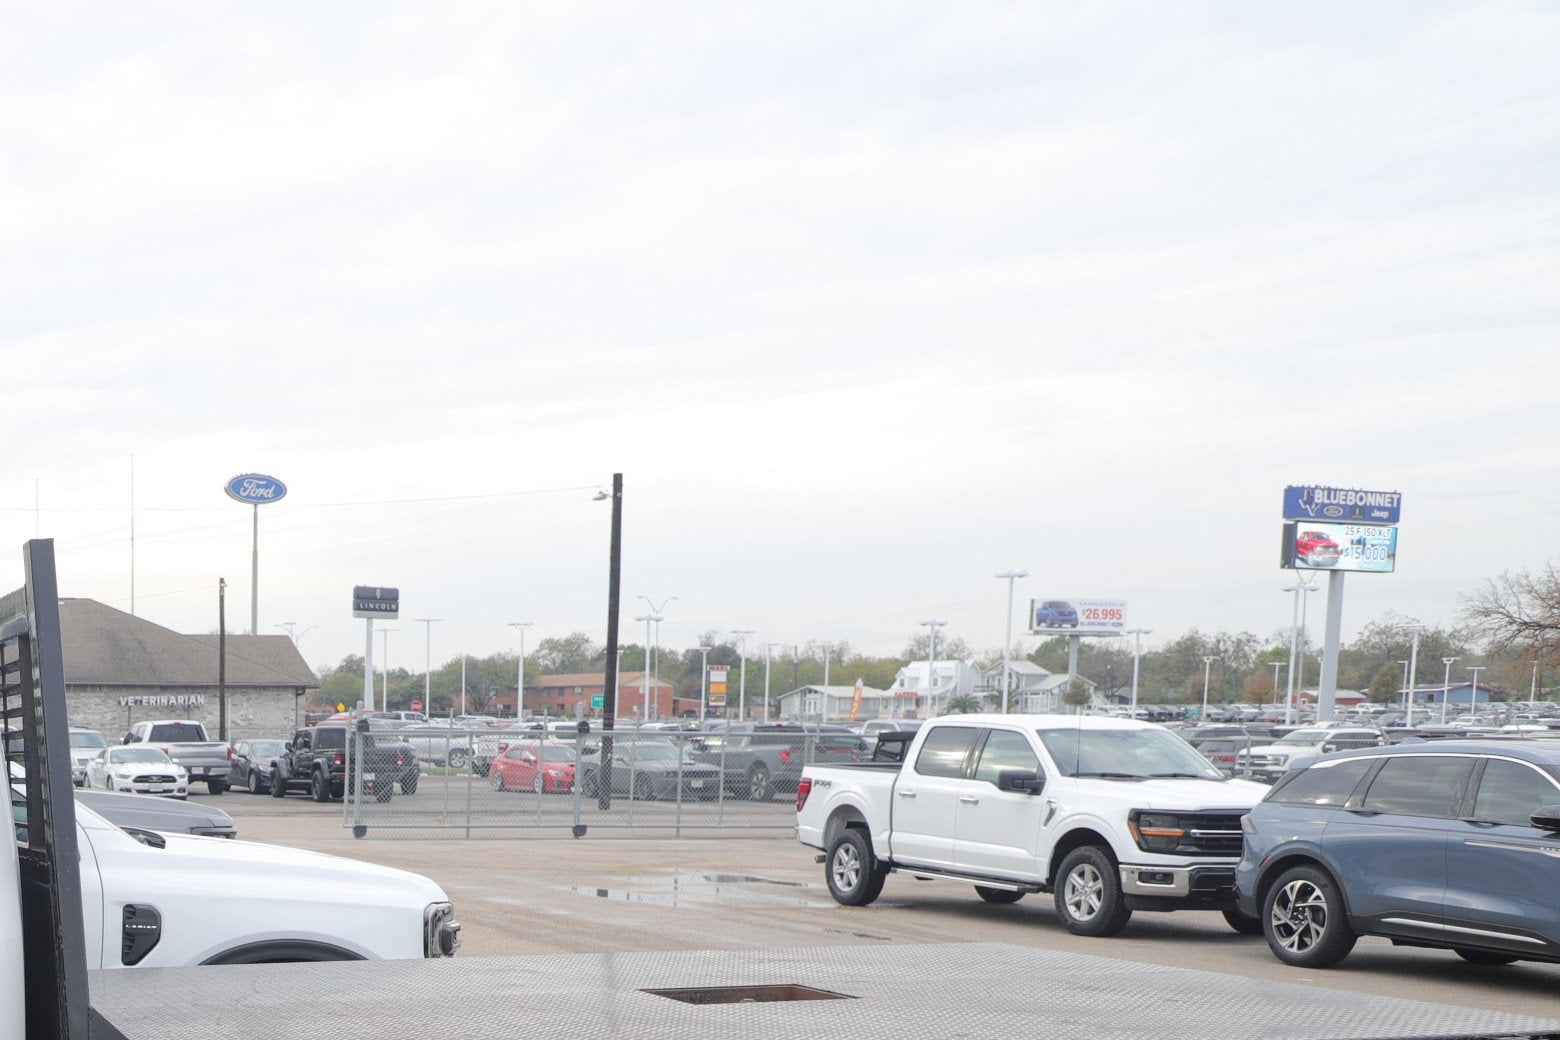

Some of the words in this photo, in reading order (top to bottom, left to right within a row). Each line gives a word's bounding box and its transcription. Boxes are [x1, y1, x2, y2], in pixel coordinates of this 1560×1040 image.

[240, 479, 275, 497] Ford
[1314, 489, 1400, 507] BLUEBONNET
[1371, 509, 1389, 518] Jeep
[1378, 529, 1391, 538] XLT
[1343, 546, 1387, 560] $15,000
[360, 602, 397, 610] LINCOLN
[120, 695, 205, 706] VETERINARIAN
